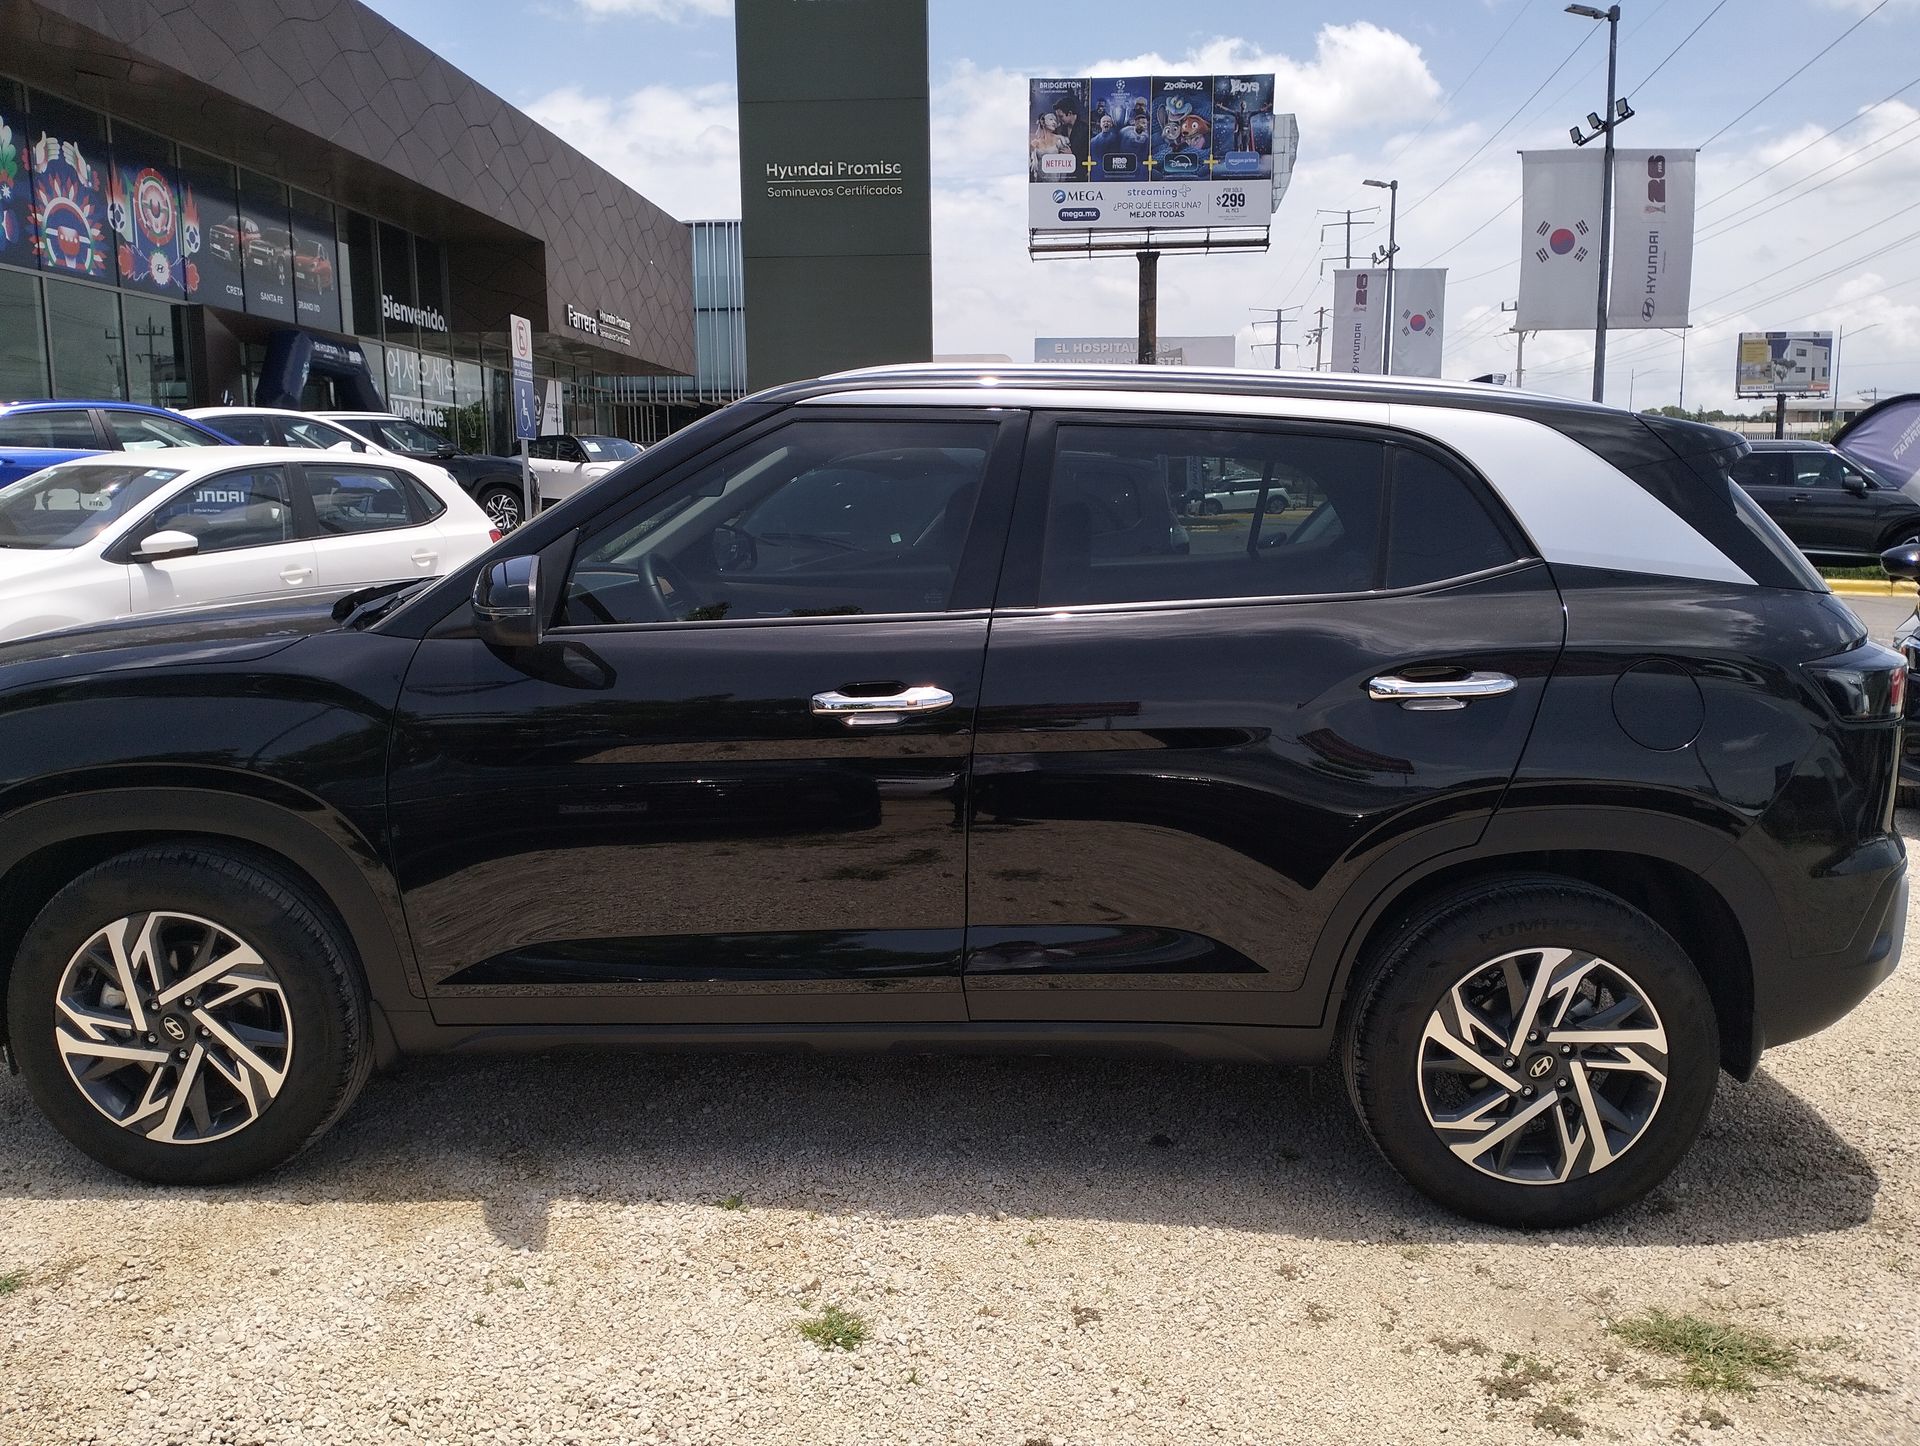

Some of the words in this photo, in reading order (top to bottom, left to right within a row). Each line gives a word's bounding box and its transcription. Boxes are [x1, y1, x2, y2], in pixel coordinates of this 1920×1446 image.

[1039, 81, 1081, 89] BRIDGERTON
[766, 161, 833, 179] Hyundai
[837, 160, 902, 176] Promise
[1045, 160, 1072, 168] NETFLIX
[767, 186, 834, 198] Seminuevos
[836, 185, 903, 197] Certificados
[1067, 190, 1104, 201] MEGA
[1127, 186, 1178, 198] streaming
[1113, 202, 1134, 212] ¿POR
[1154, 201, 1180, 210] ELEGIR
[1181, 201, 1202, 209] UNA?
[1216, 193, 1246, 208] $299
[1061, 209, 1097, 219] mega.mx
[1129, 211, 1157, 219] MEJOR
[1158, 210, 1185, 218] TODAS
[1645, 230, 1659, 294] HYUNDAI
[226, 284, 244, 296] CRETA
[260, 291, 278, 302] SANTA
[382, 294, 448, 333] Bienvenido.
[567, 303, 597, 335] Farrera
[1055, 344, 1070, 354] EL
[1073, 343, 1138, 353] HOSPITAL
[1352, 323, 1362, 364] HYUNDAI
[389, 399, 447, 428] Welcome.
[193, 490, 245, 503] UNDAI
